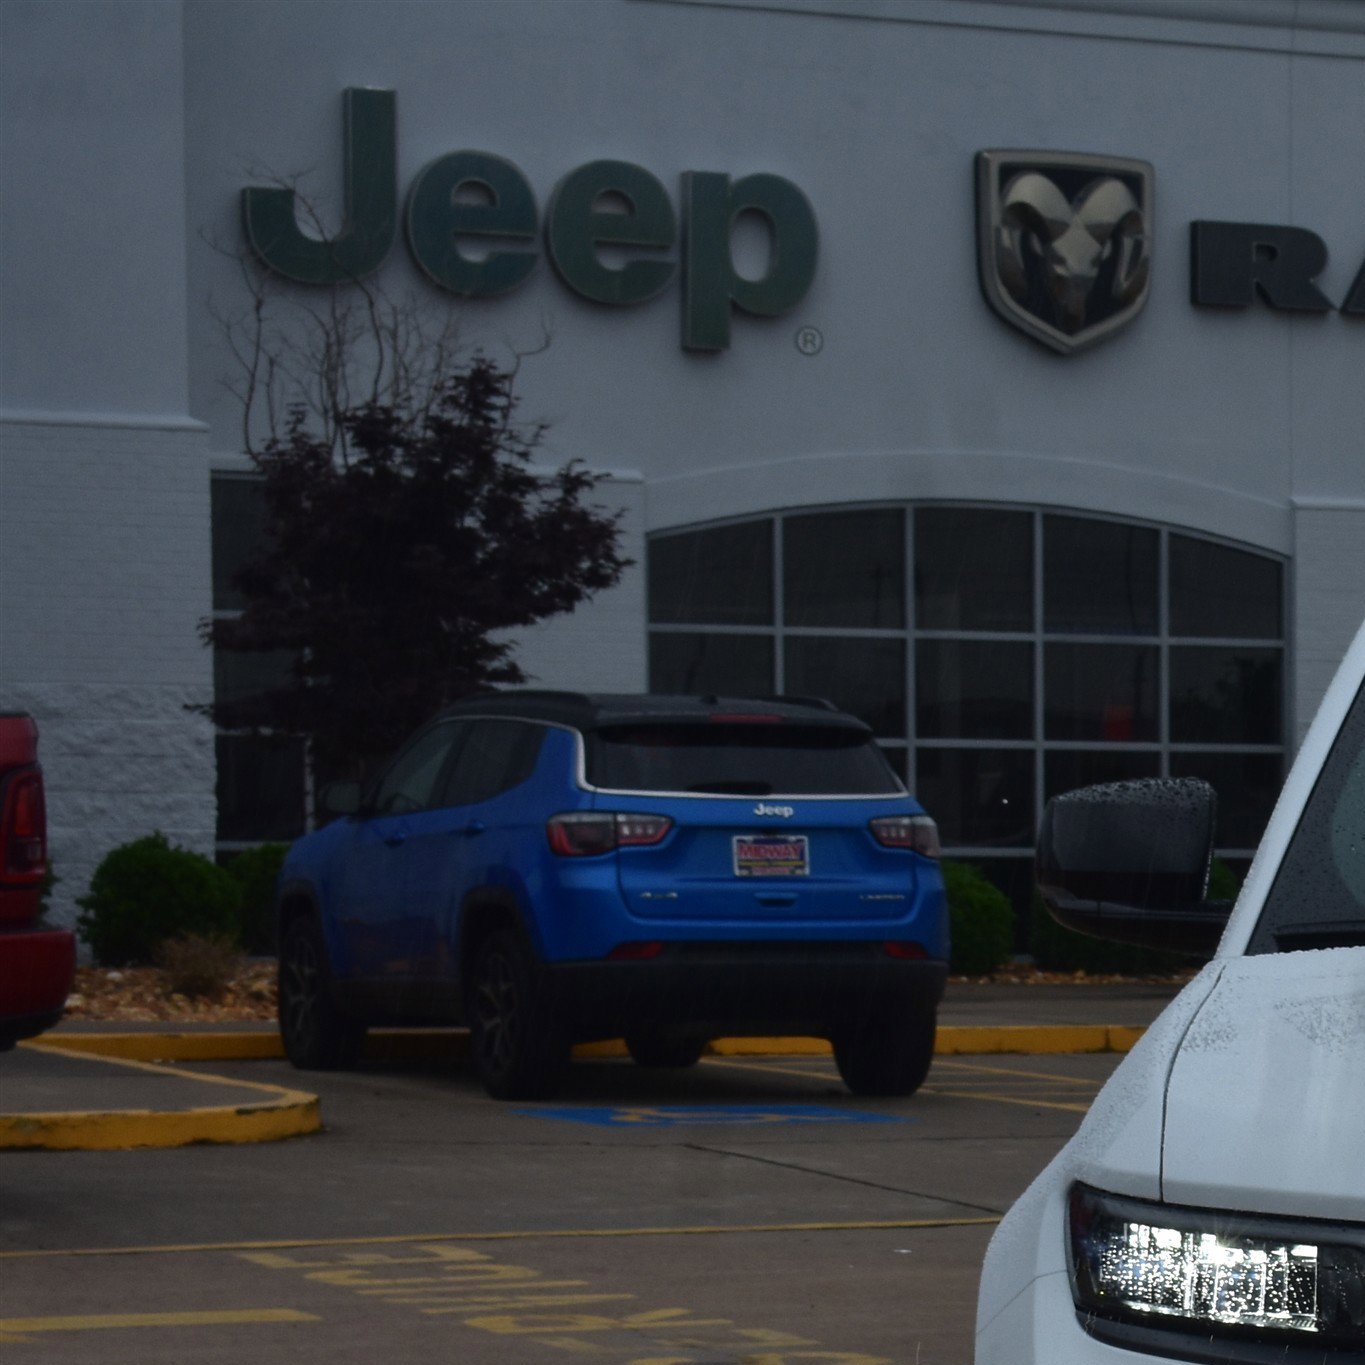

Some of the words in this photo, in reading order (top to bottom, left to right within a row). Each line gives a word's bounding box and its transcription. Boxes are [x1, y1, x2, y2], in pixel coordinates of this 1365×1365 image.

[241, 86, 820, 352] Jeep
[753, 803, 794, 818] Jeep
[739, 844, 802, 860] MIDWAY
